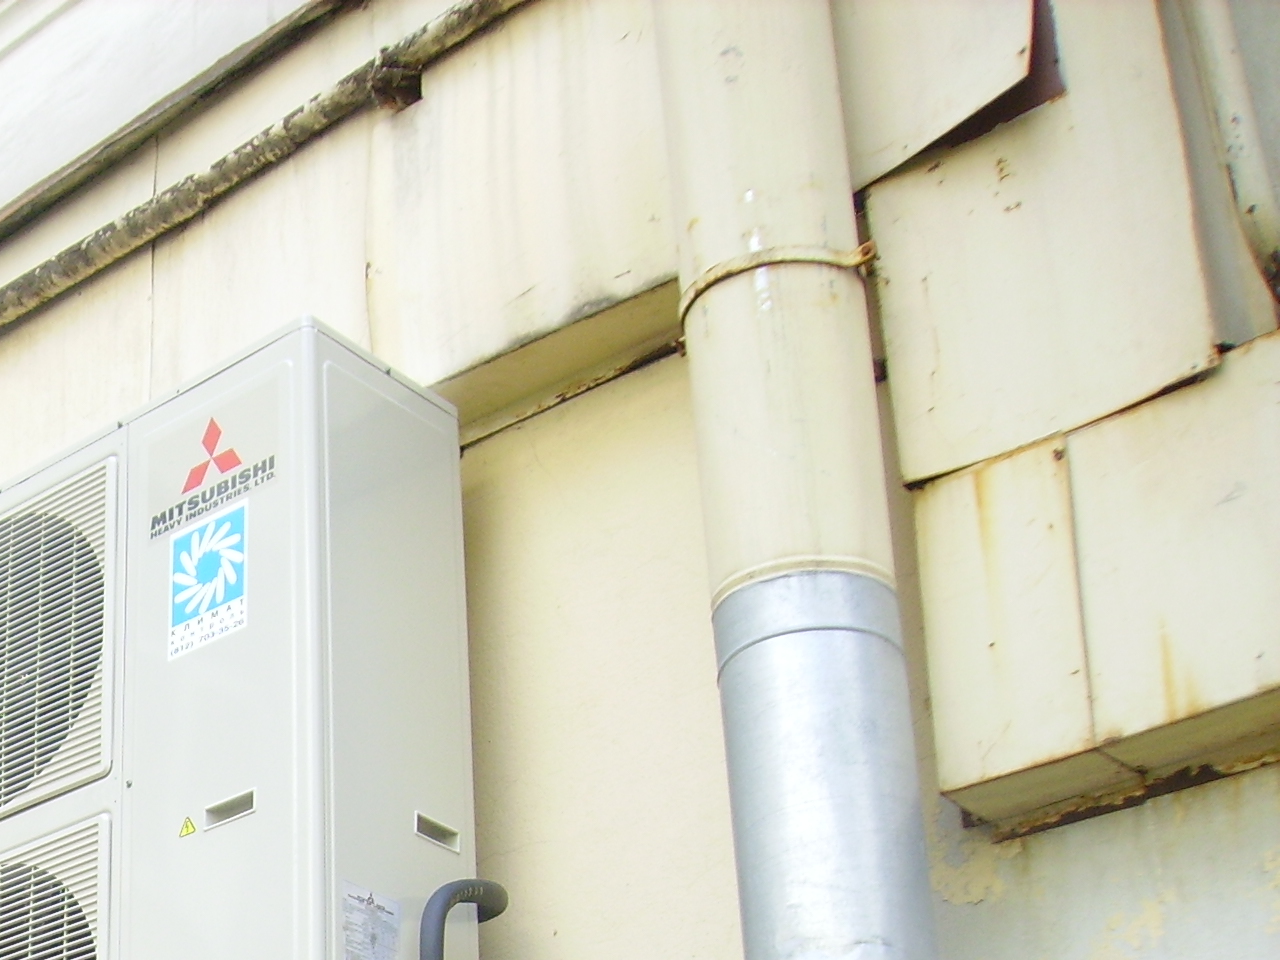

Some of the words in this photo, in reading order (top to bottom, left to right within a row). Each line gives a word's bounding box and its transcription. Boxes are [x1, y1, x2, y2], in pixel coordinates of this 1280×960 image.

[150, 454, 275, 531] MITSUBISHI
[150, 517, 186, 540] HEAVY
[254, 471, 277, 487] LTD.
